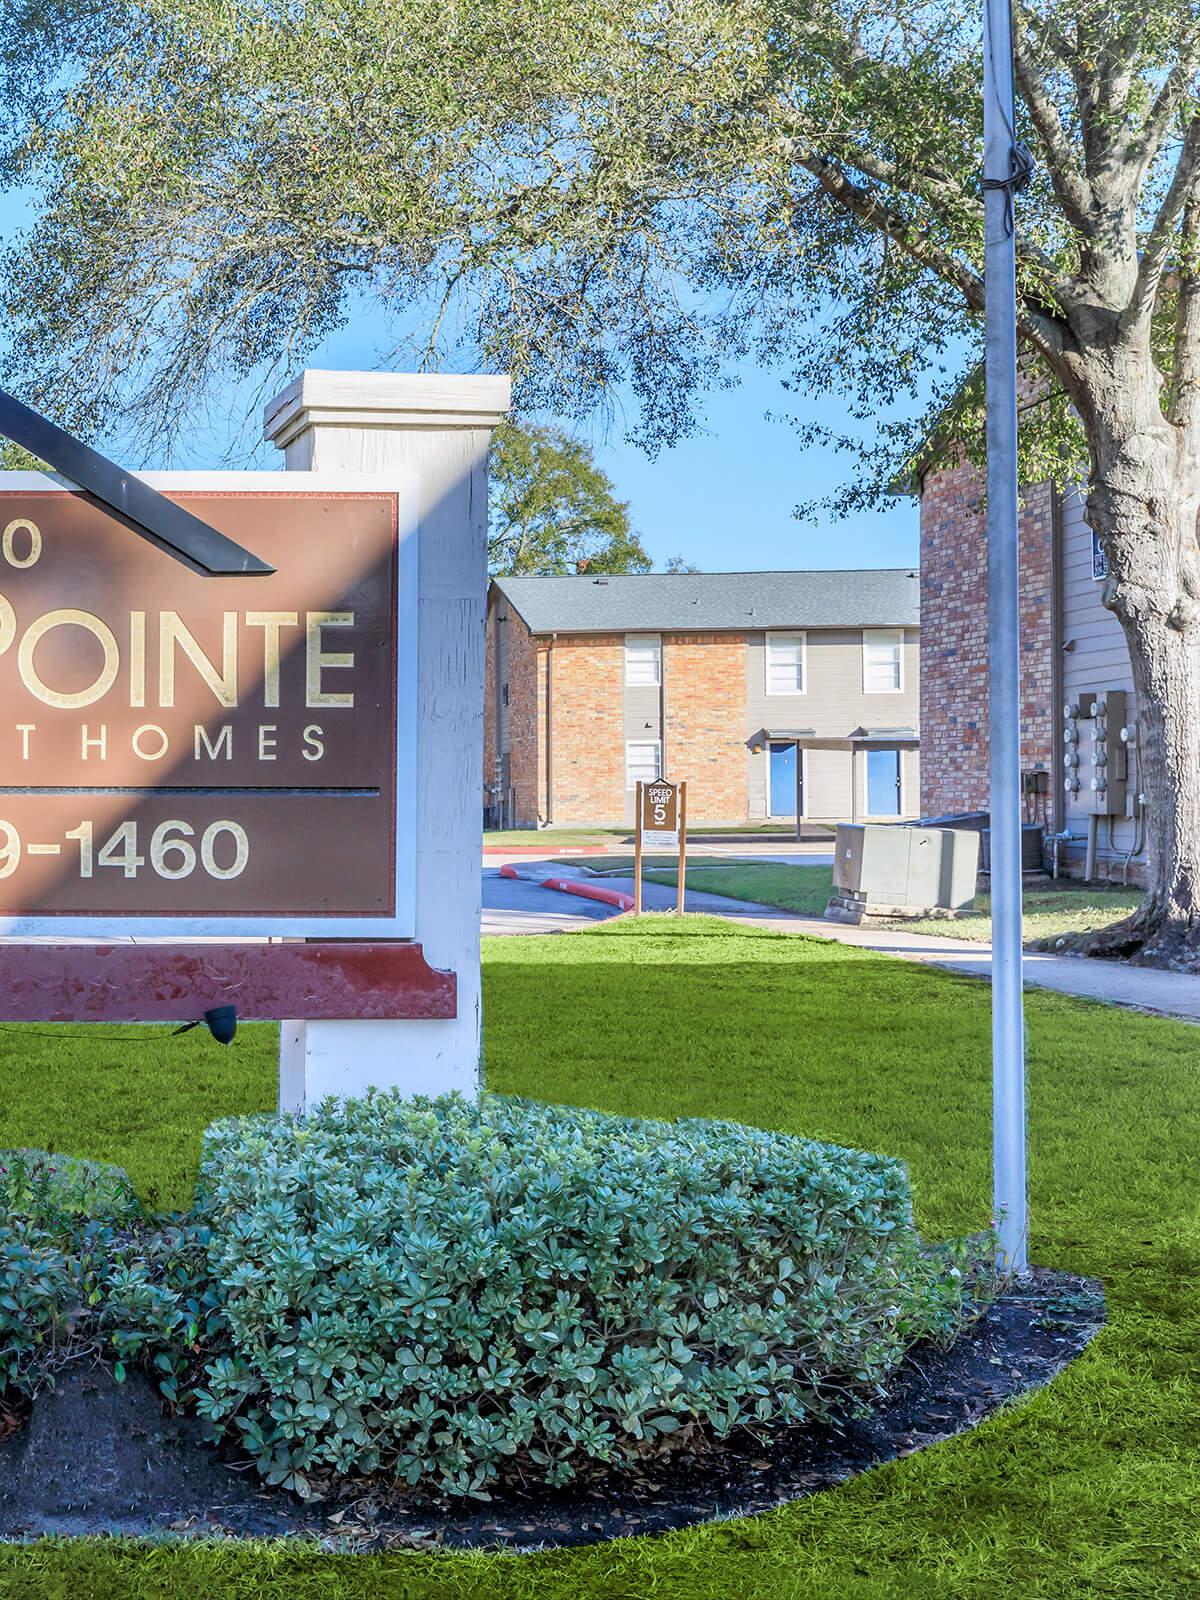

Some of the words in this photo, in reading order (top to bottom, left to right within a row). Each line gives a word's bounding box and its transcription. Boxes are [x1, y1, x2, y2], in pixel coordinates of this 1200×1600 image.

[80, 723, 326, 761] HOMES
[648, 788, 672, 796] SPEED
[654, 804, 666, 820] 5
